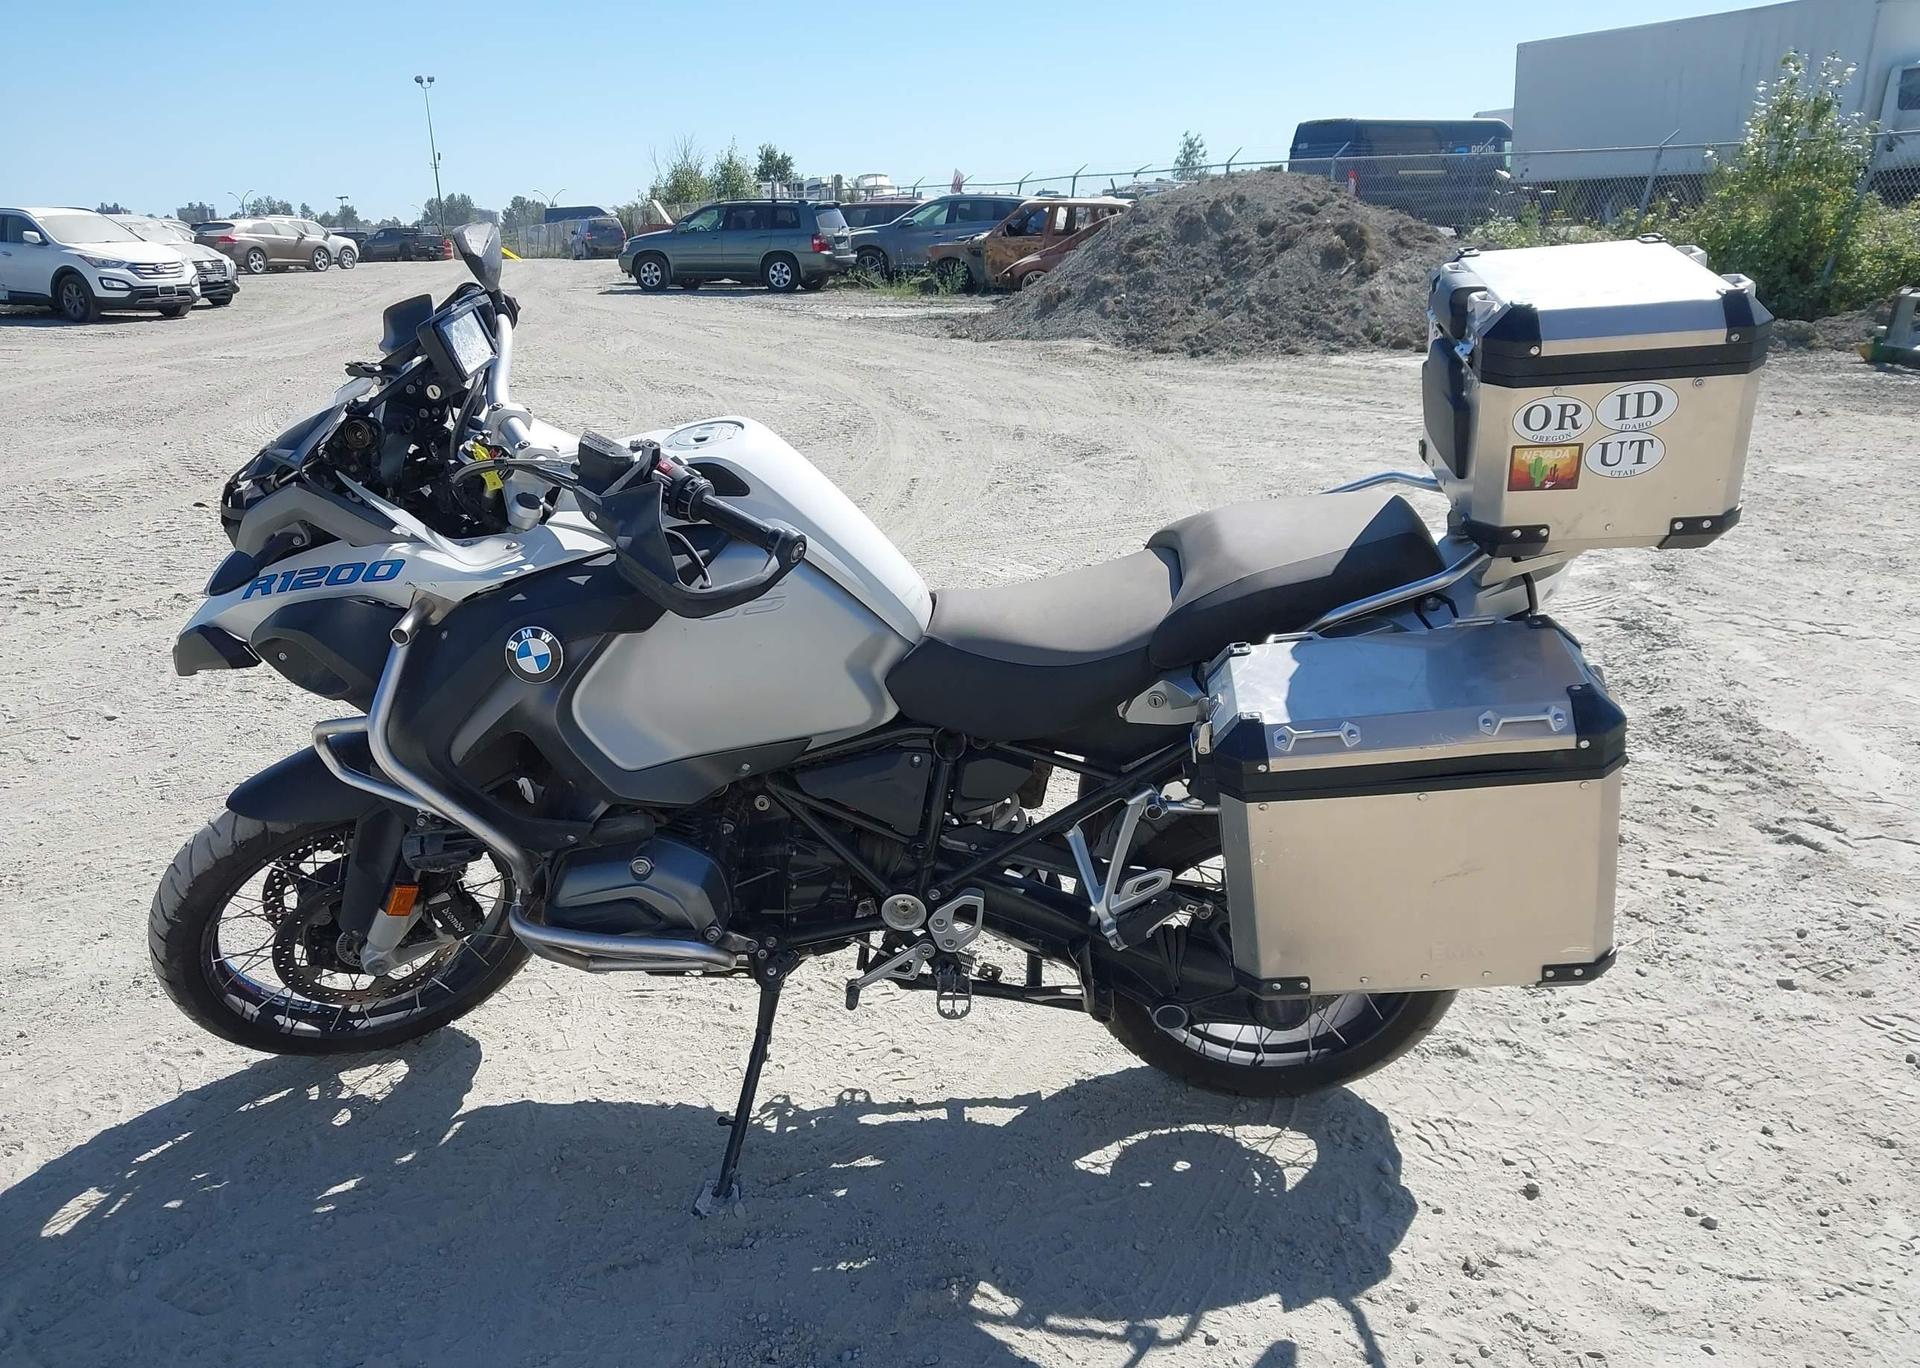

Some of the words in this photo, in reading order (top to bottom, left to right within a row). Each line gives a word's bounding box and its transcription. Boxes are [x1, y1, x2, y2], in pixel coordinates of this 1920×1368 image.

[1523, 403, 1583, 432] OR
[1614, 390, 1663, 422] ID
[1531, 432, 1572, 442] OREGON
[1620, 421, 1652, 431] IDAHO
[1522, 448, 1570, 461] NEVADA
[1599, 438, 1654, 467] UT
[1610, 469, 1636, 477] UTAH
[241, 558, 406, 600] R1200
[508, 628, 553, 651] BMW
[442, 906, 465, 932] brembo
